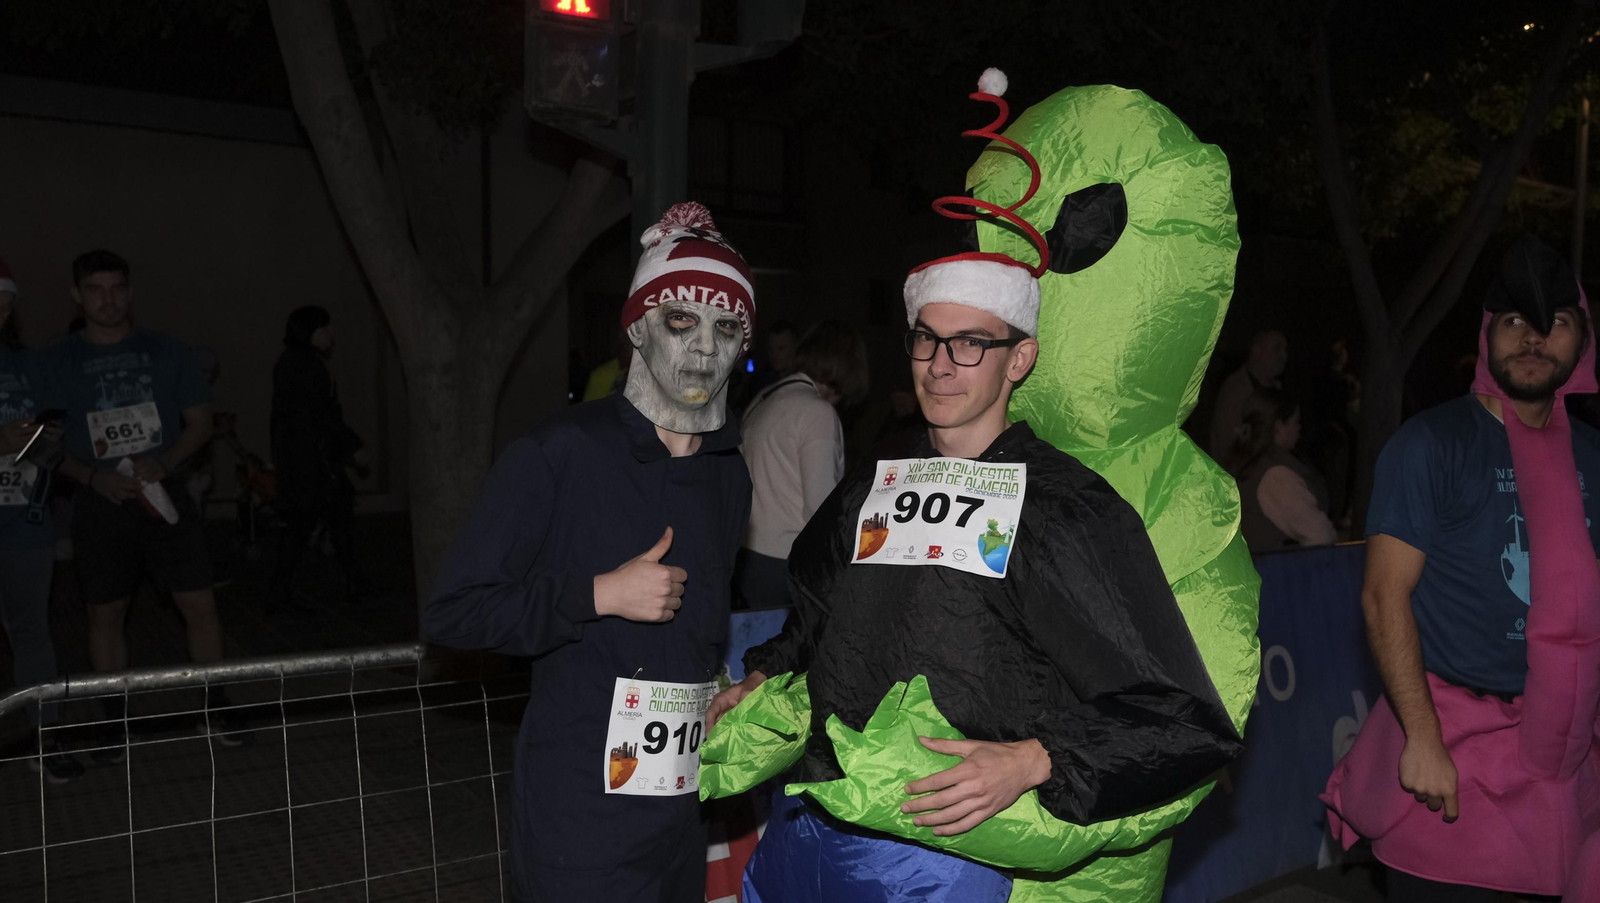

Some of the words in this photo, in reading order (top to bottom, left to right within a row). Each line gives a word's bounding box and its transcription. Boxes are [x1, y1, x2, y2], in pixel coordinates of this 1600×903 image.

[643, 285, 731, 311] SANTA
[105, 421, 144, 440] 661
[903, 473, 943, 484] CIUDAD
[945, 474, 962, 485] DE
[908, 461, 926, 474] XIV
[927, 462, 951, 474] SAN
[952, 462, 1019, 481] SILVESTRE
[893, 491, 985, 528] 907
[651, 686, 669, 699] XIV
[671, 687, 690, 700] SAN
[649, 700, 686, 713] CIUDAD
[686, 701, 696, 713] DE
[642, 721, 702, 755] 910
